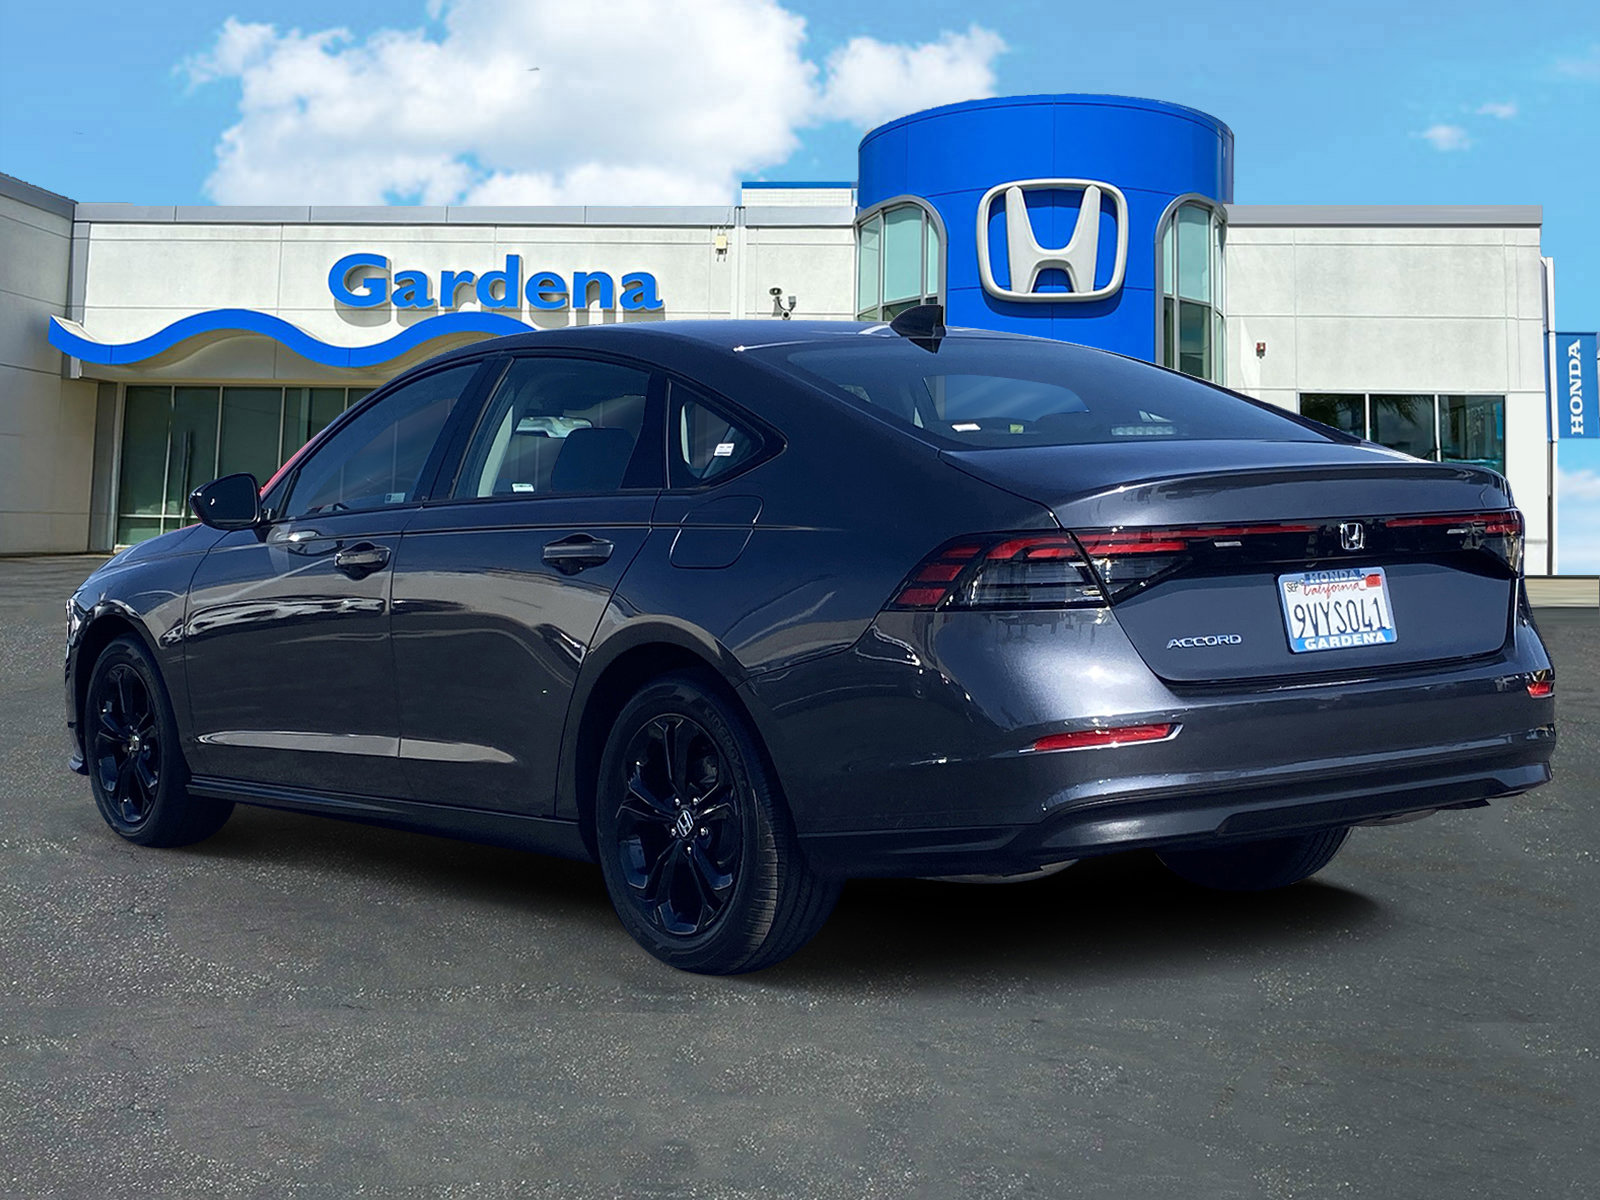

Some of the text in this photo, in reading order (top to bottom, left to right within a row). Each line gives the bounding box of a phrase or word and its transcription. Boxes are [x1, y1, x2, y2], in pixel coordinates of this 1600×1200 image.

[328, 253, 664, 309] Gardena
[1568, 339, 1584, 435] HONDA
[1309, 570, 1358, 583] HONDA
[1303, 581, 1367, 599] California
[1294, 597, 1386, 640] 9VYS041
[1166, 634, 1242, 649] ACCORD
[1304, 631, 1387, 650] GARDENA
